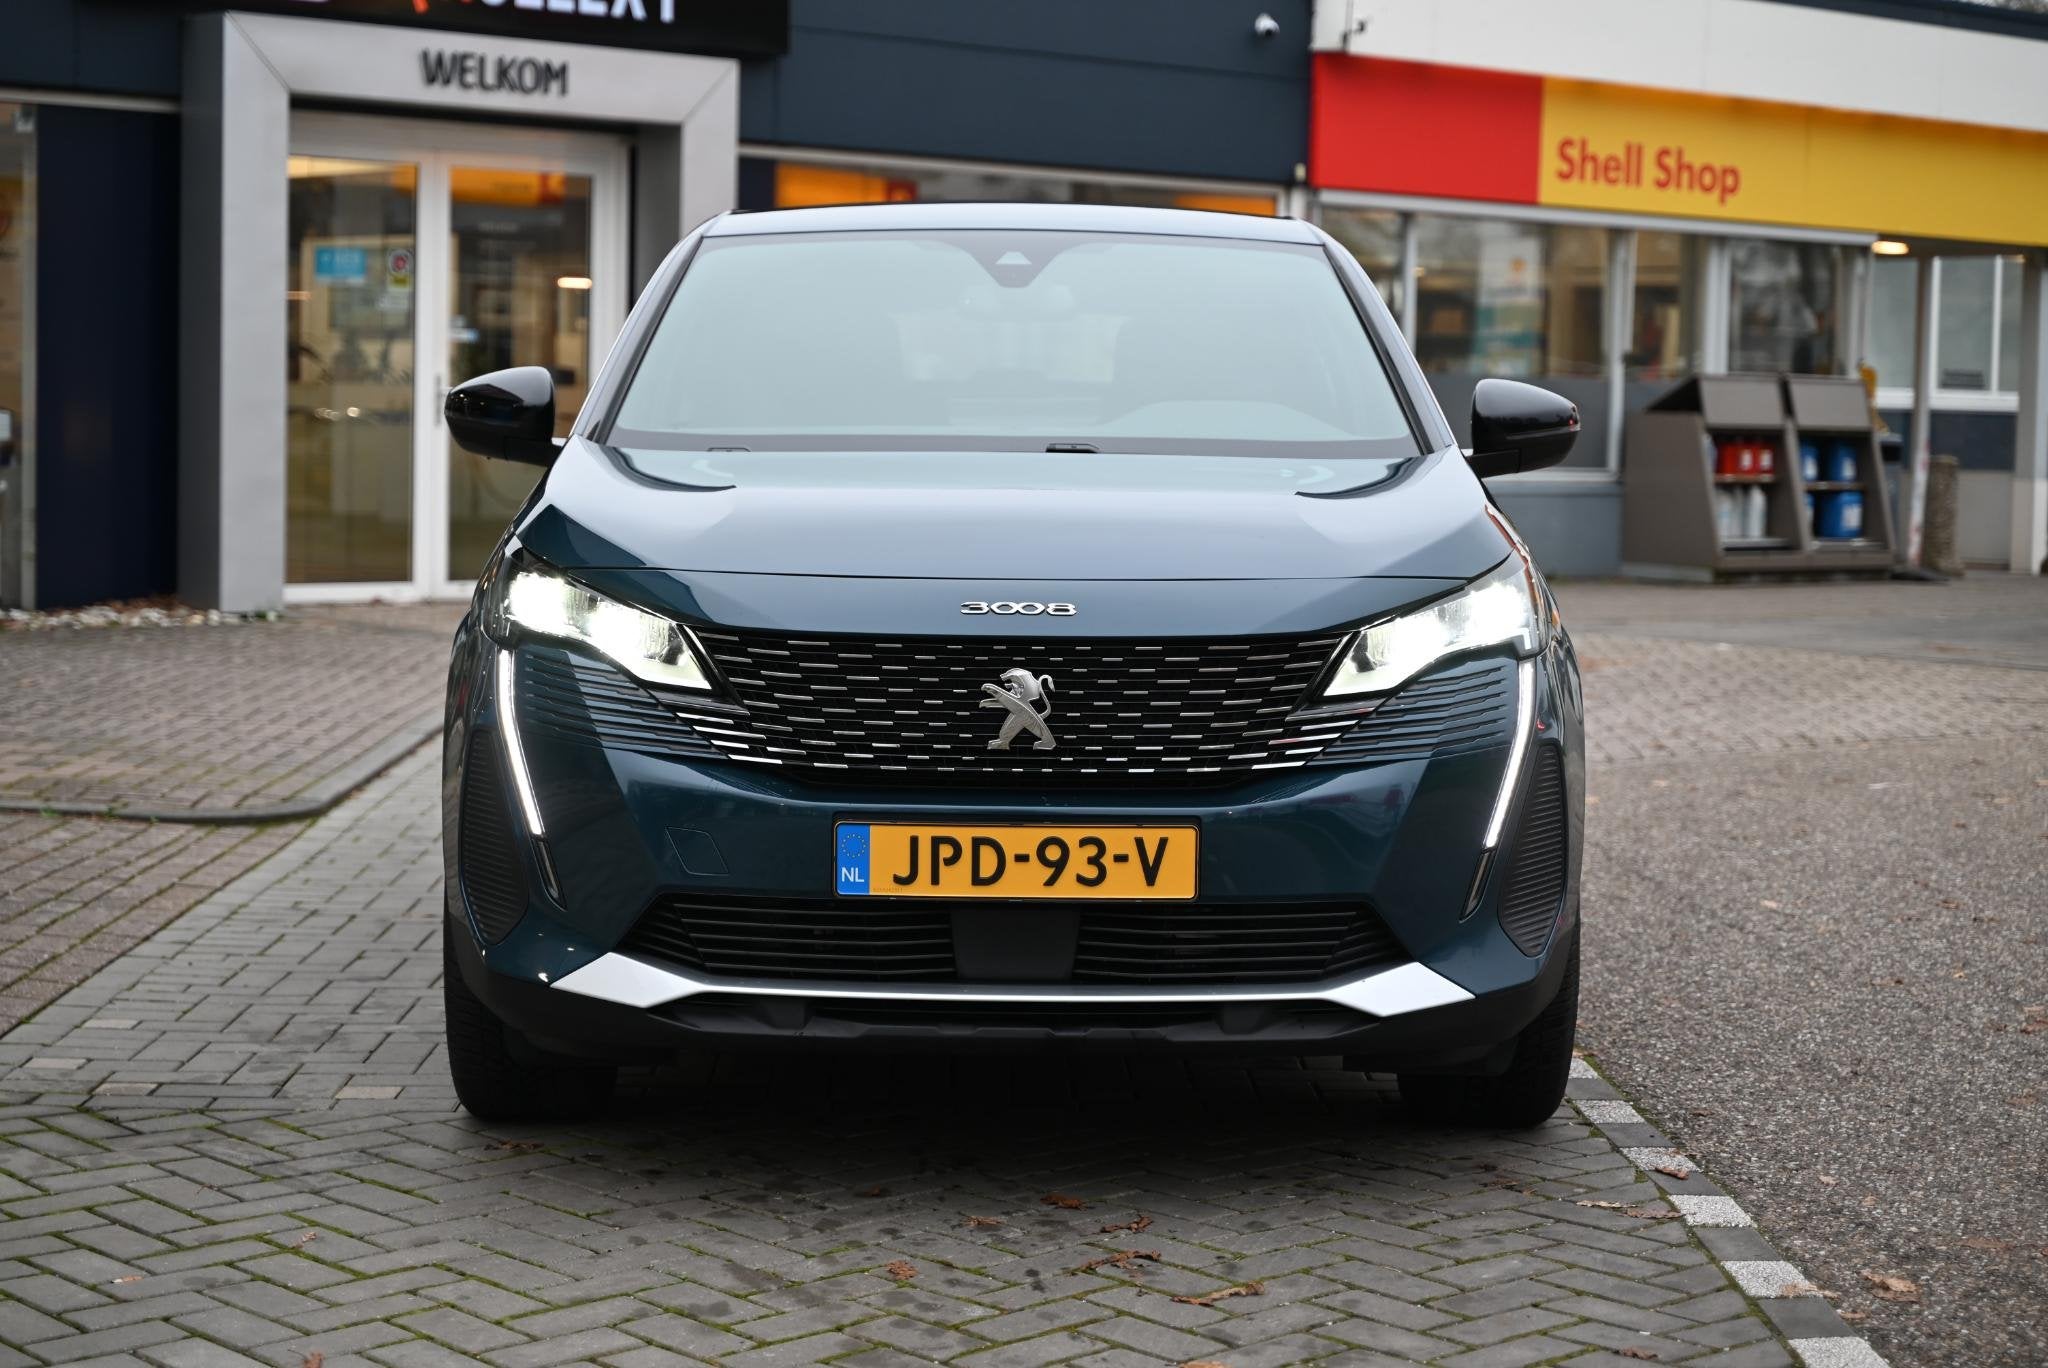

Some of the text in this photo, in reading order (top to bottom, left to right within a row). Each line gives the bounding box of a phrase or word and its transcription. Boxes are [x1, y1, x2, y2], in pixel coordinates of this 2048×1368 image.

[420, 49, 568, 97] WELKOM
[1557, 136, 1741, 206] Shell Shop
[960, 601, 1078, 616] 3008
[841, 867, 865, 883] NL
[892, 835, 1169, 888] JPD-93-V
